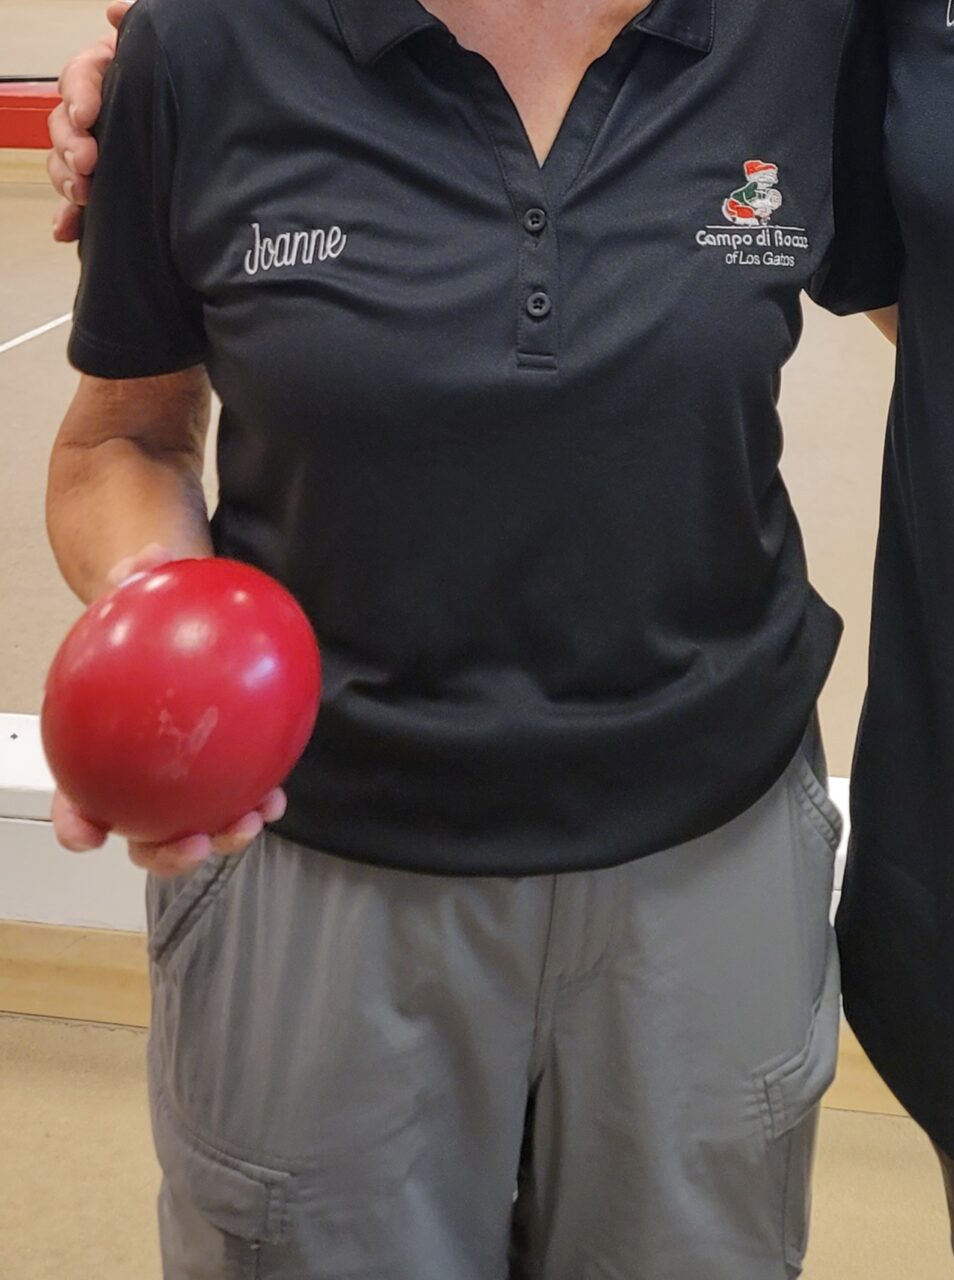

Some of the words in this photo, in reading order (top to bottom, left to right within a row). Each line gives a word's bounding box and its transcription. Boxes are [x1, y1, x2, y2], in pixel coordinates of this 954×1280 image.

[244, 222, 347, 275] Joanne
[695, 230, 753, 249] Campo
[756, 229, 771, 246] di
[725, 251, 739, 264] of
[739, 251, 760, 265] Los
[763, 252, 795, 267] Gatos
